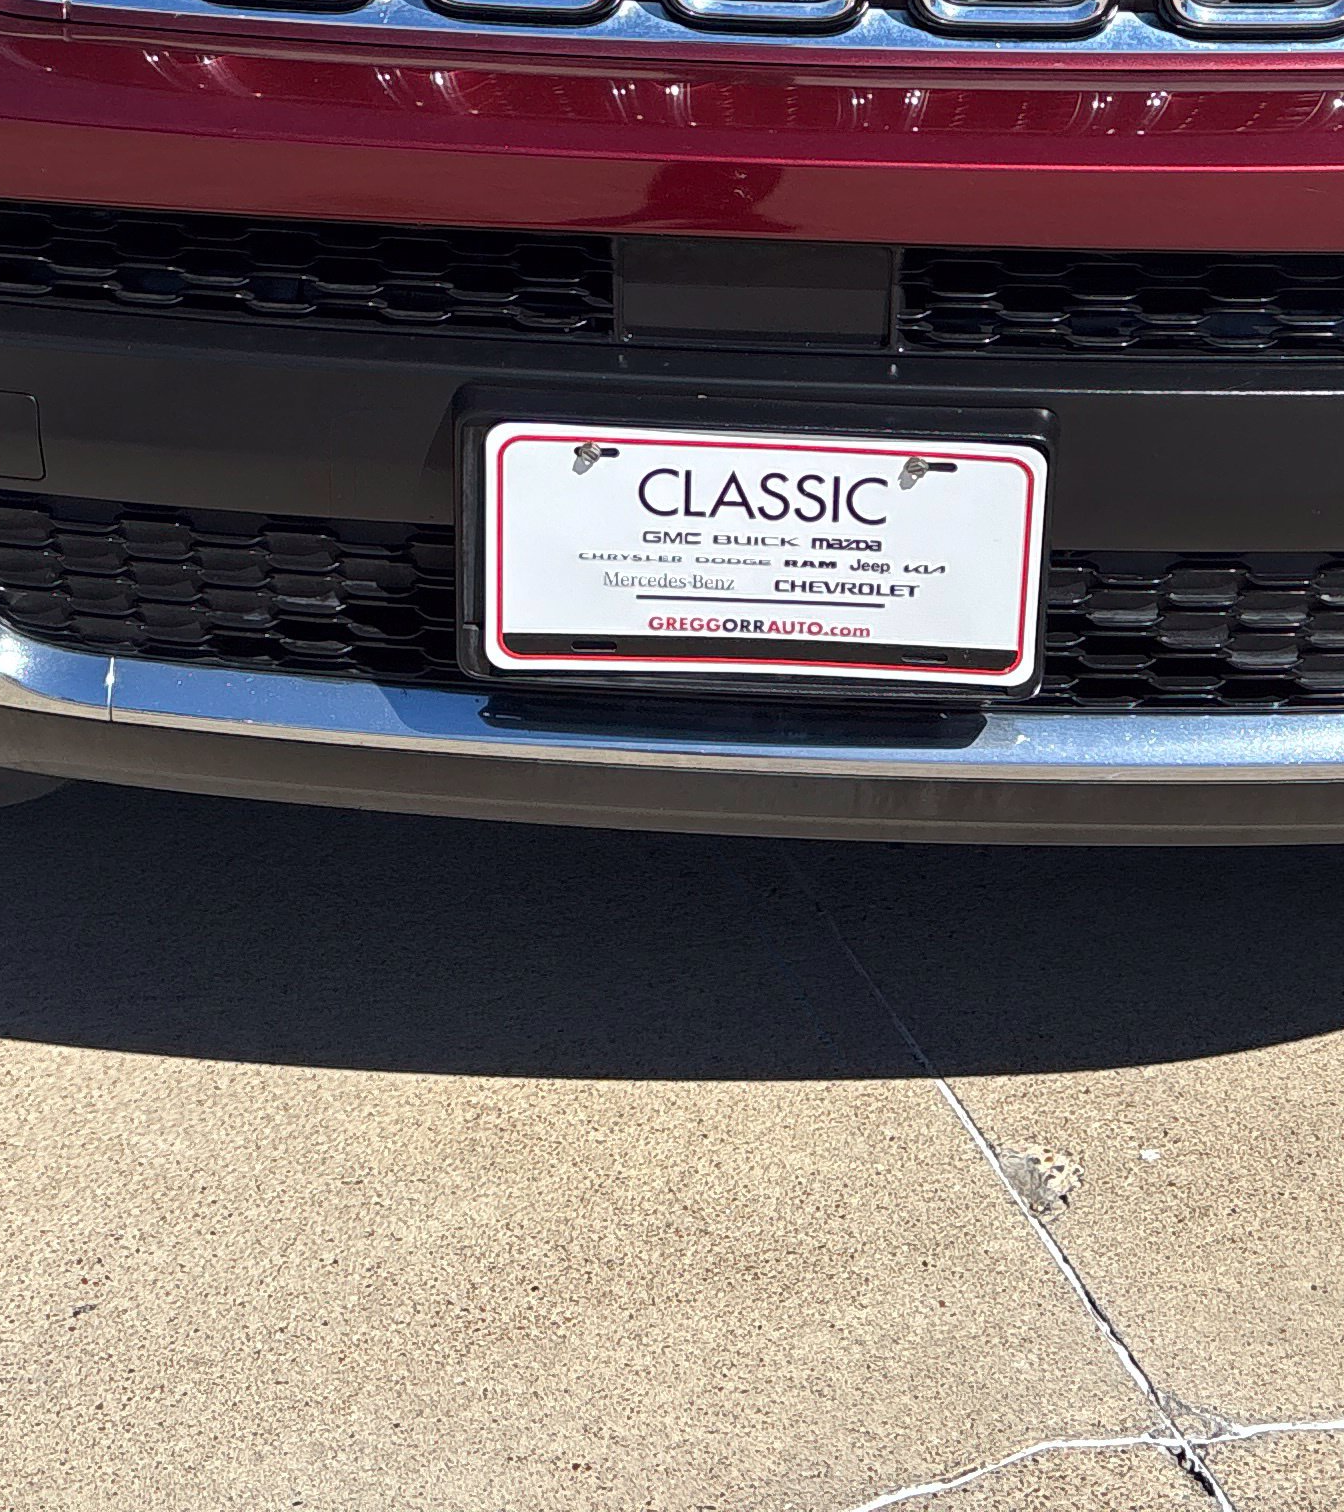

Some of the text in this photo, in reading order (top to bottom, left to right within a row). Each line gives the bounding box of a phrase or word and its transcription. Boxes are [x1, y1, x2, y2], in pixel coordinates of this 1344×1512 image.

[637, 467, 889, 526] CLASSIC
[641, 530, 703, 545] GMC
[712, 533, 800, 548] BUICK
[578, 552, 947, 575] CHRYSLER DODGE RAM Jeep KIA
[602, 570, 921, 598] Mercedes-Benz CHEVROLET
[647, 615, 871, 638] GREGGORRAUTO.com
